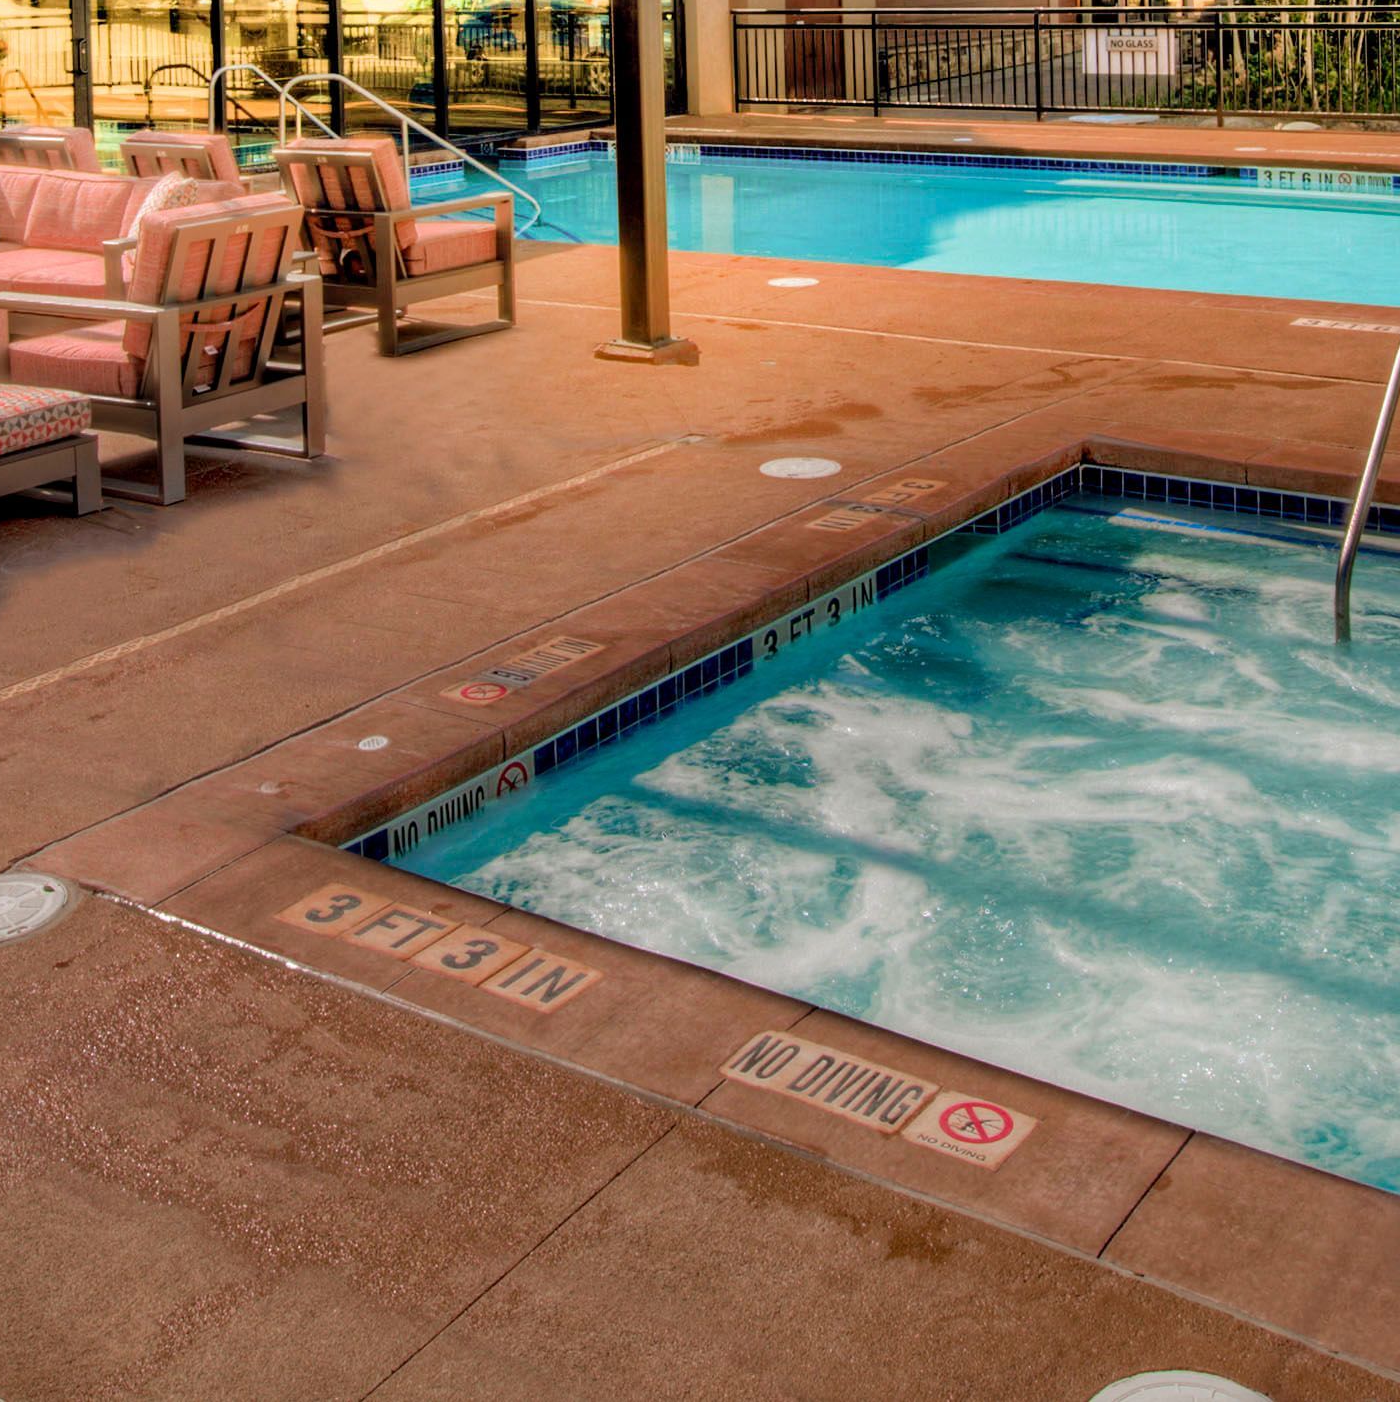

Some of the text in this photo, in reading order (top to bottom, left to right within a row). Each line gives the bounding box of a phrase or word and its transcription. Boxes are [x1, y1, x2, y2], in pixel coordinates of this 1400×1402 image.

[1110, 40, 1154, 48] NO GLASS
[1279, 171, 1296, 183] FT
[1302, 172, 1311, 183] 6
[1318, 173, 1333, 184] IN
[1355, 175, 1366, 186] NO
[902, 481, 935, 490] 3
[814, 515, 864, 530] IN
[848, 505, 883, 513] 3
[764, 578, 873, 660] 3 FT 3 IN
[492, 637, 600, 682] NO DIVING
[393, 785, 485, 858] NO DIVING
[305, 894, 588, 1004] 3 FT 3 IN
[730, 1035, 923, 1126] NO DIVING
[917, 1133, 986, 1162] NO DIVING
